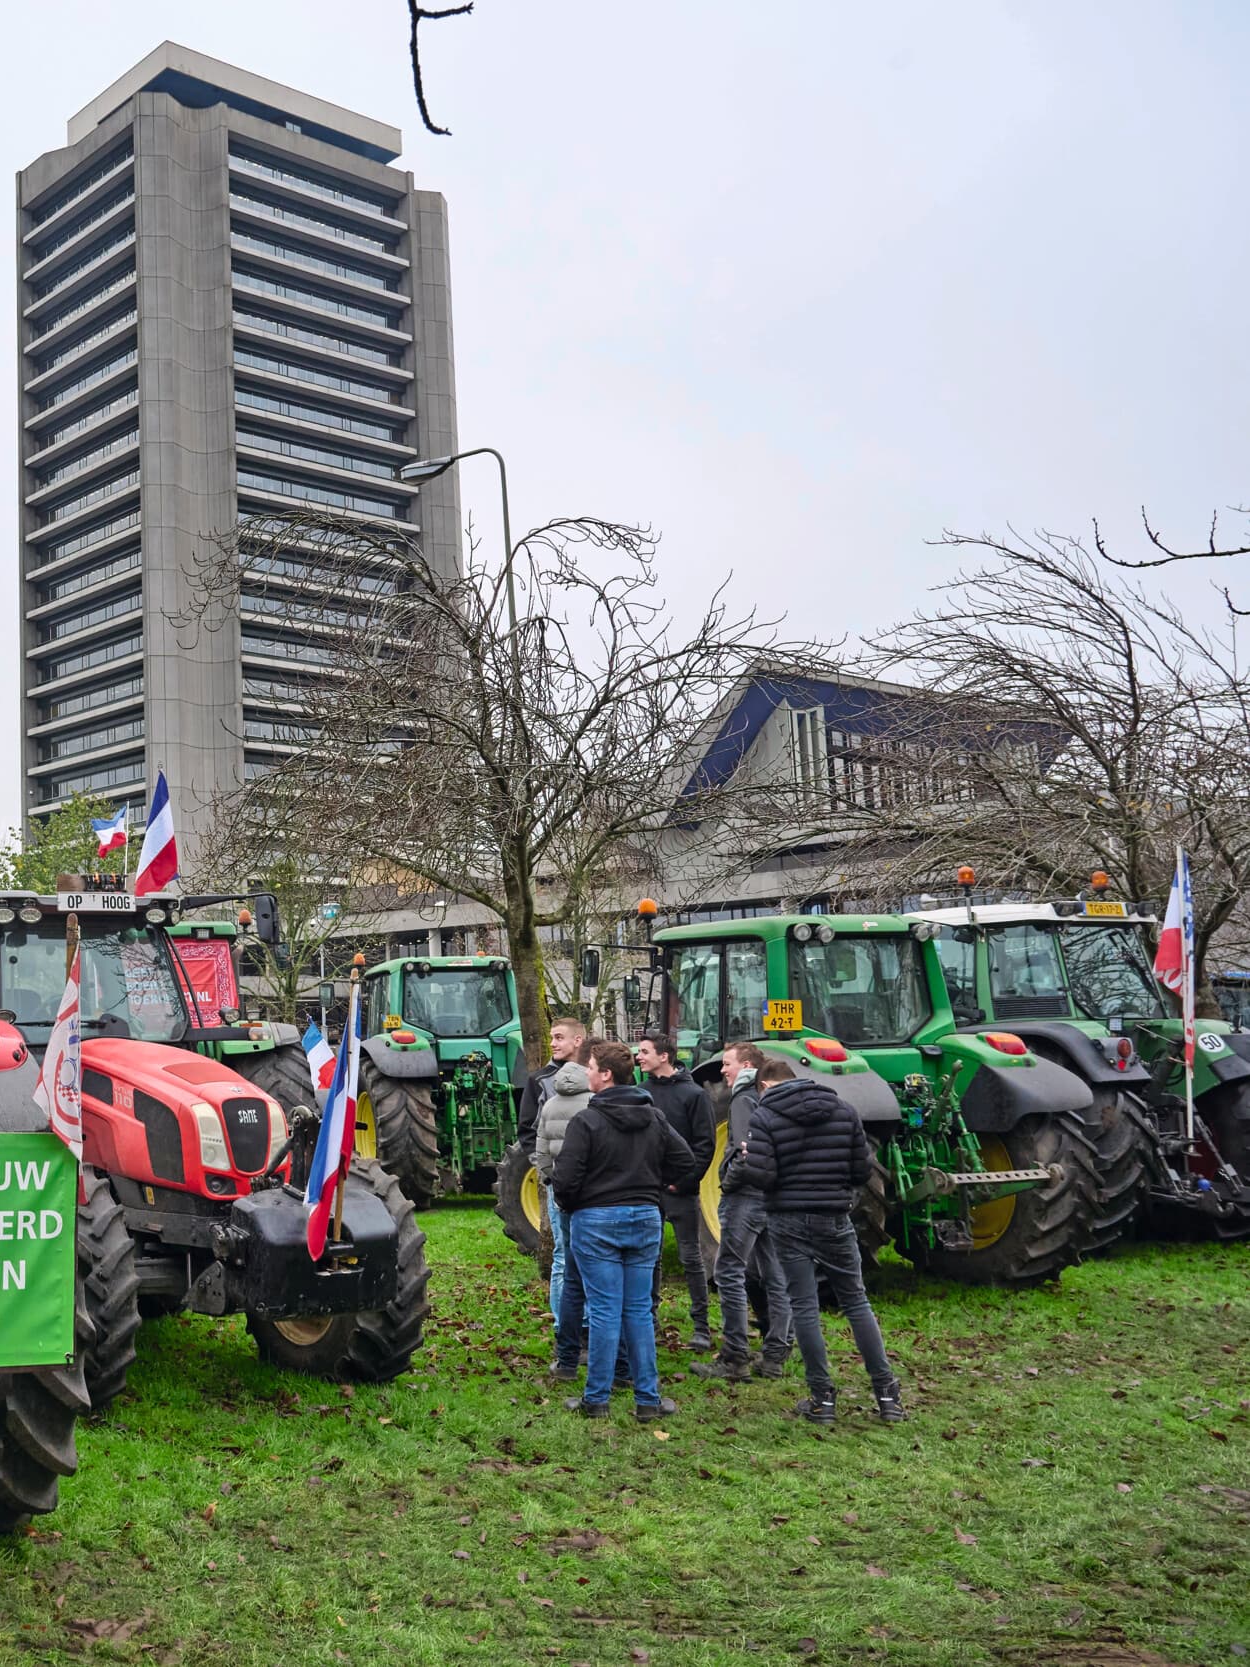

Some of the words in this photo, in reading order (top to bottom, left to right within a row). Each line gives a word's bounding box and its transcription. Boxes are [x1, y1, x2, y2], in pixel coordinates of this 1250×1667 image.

[67, 895, 82, 909] OP
[102, 895, 130, 909] HOOG
[774, 1002, 795, 1014] THR
[770, 1017, 794, 1029] 42-T
[1200, 1034, 1222, 1050] 50
[237, 1109, 258, 1124] SAME
